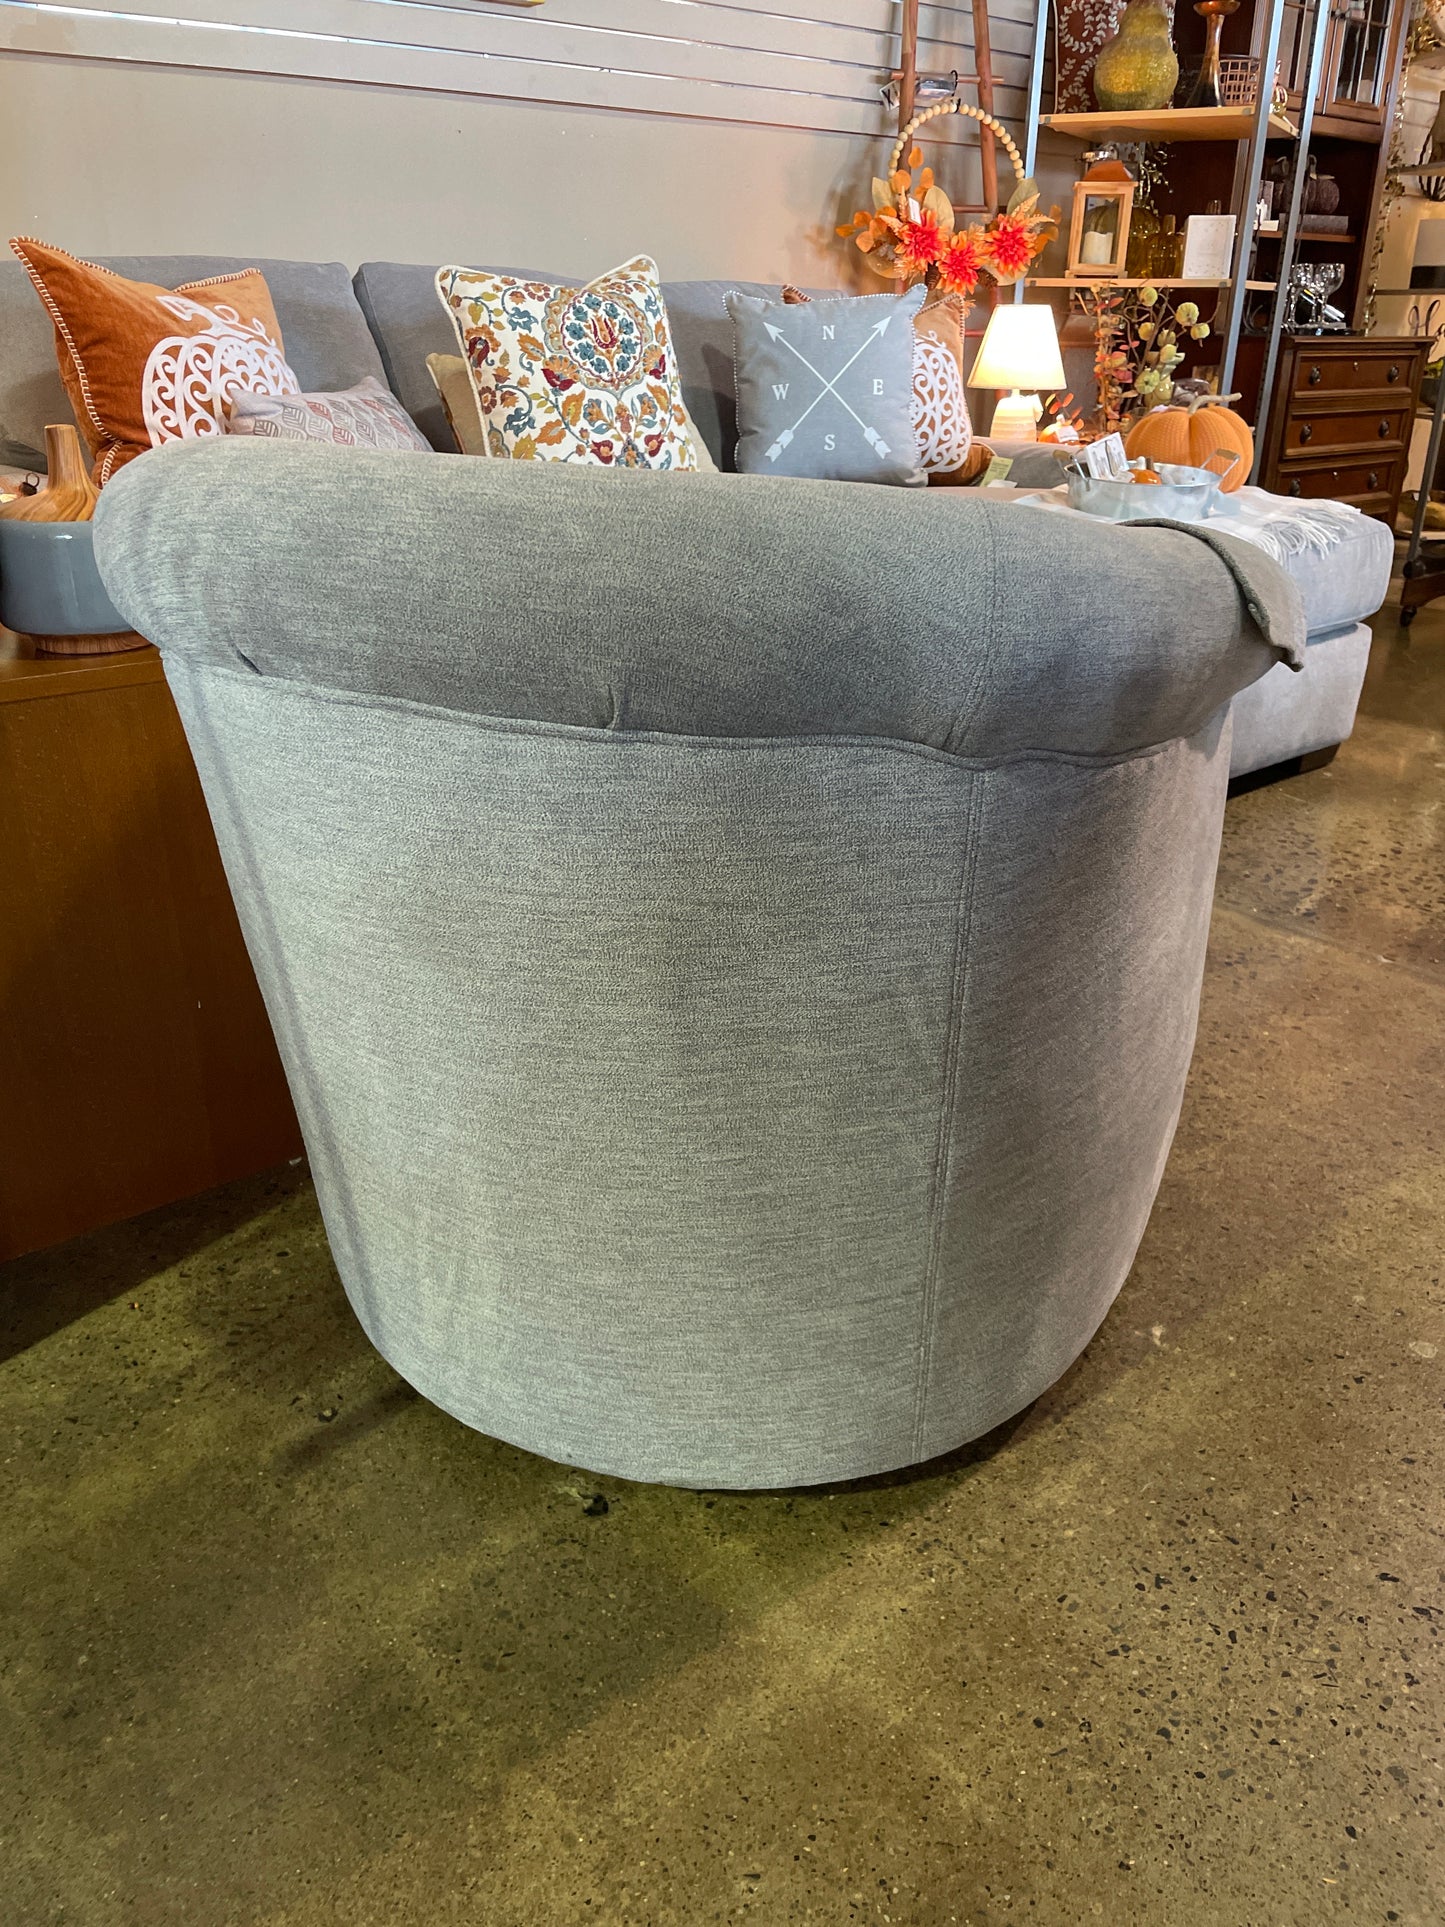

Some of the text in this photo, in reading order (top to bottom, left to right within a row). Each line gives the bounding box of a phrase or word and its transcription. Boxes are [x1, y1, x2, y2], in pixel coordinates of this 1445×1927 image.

[822, 325, 835, 341] N
[771, 383, 790, 401] W
[872, 378, 884, 396] E
[824, 434, 836, 451] S
